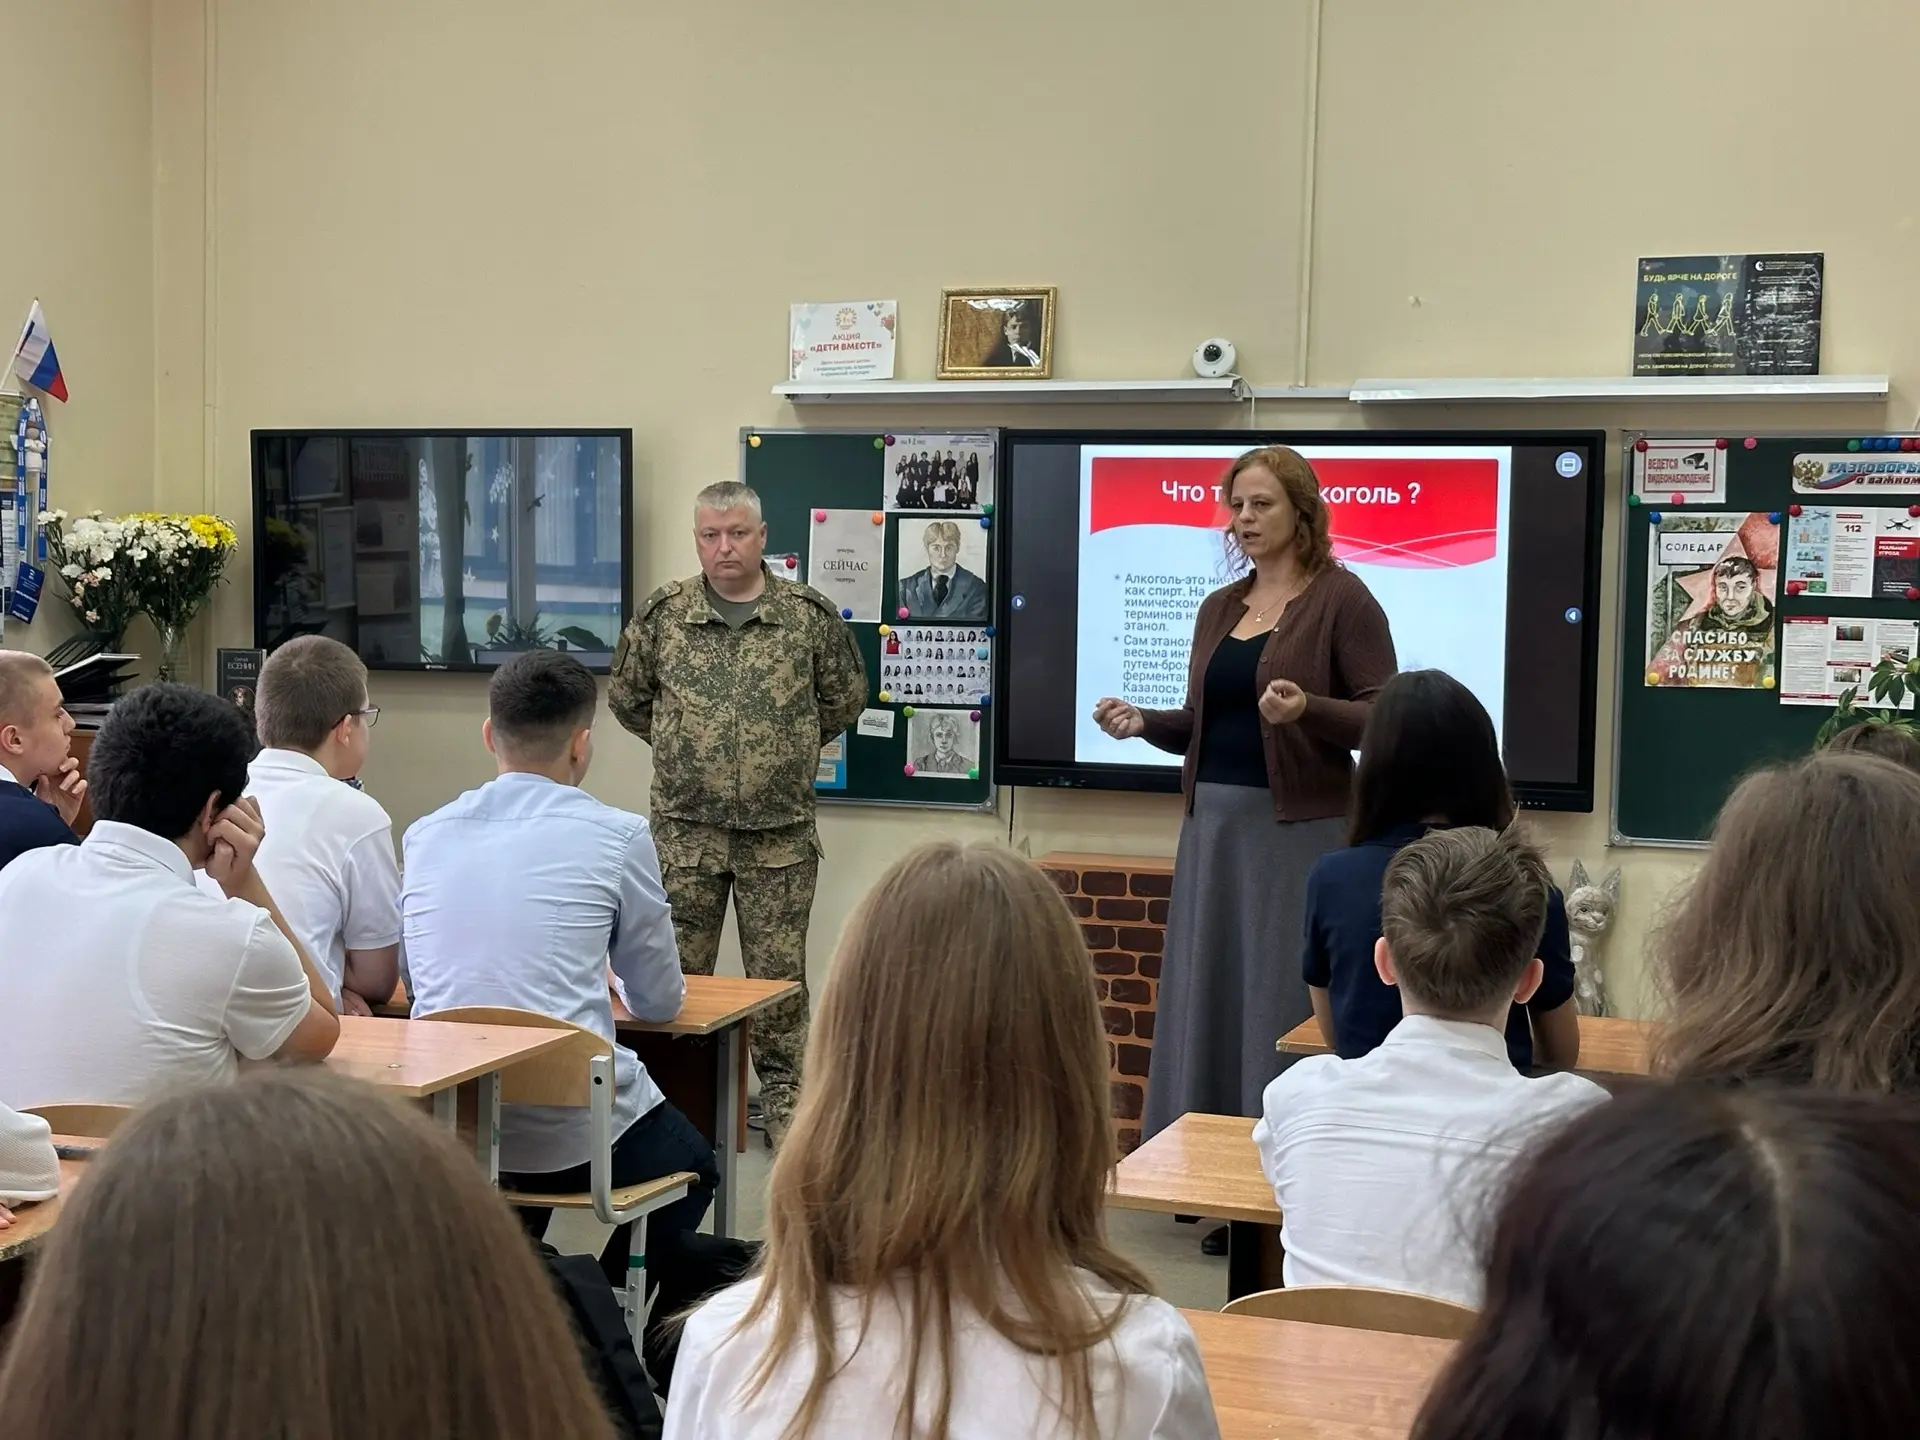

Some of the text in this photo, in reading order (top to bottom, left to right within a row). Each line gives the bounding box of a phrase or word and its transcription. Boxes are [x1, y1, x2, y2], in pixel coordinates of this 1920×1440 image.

[1643, 272, 1738, 283] БУДЬ ЯРЧЕ НА ДОРОГЕ
[831, 333, 861, 341] АКЦИЯ
[809, 341, 882, 352] «ДЕТИ ВМЕСТЕ»
[1648, 458, 1679, 471] ВЕДЕТСЯ
[1648, 473, 1710, 485] ВИДЕОНАБЛЮДЕНИЕ
[1161, 480, 1205, 503] Что
[1319, 486, 1401, 504] коголь
[1407, 481, 1421, 505] ?
[1844, 524, 1862, 533] 112
[1665, 542, 1723, 553] СОЛЕДАР
[823, 559, 868, 571] СЕЙЧАС
[1124, 573, 1205, 585] Алкоголь-это
[1124, 586, 1205, 598] как спирт. На
[1124, 599, 1199, 609] химическом
[1124, 610, 1183, 621] терминов
[1124, 621, 1169, 632] этанол.
[1124, 634, 1148, 646] Сам
[1671, 631, 1748, 645] СПАСИБО
[1124, 648, 1190, 658] весьма инт
[1664, 648, 1756, 662] ЗА СЛУЖБУ
[1123, 670, 1188, 682] ферментац
[1668, 664, 1737, 680] РОДИНЕ!
[1123, 682, 1179, 694] Казалось
[1161, 696, 1176, 706] не
